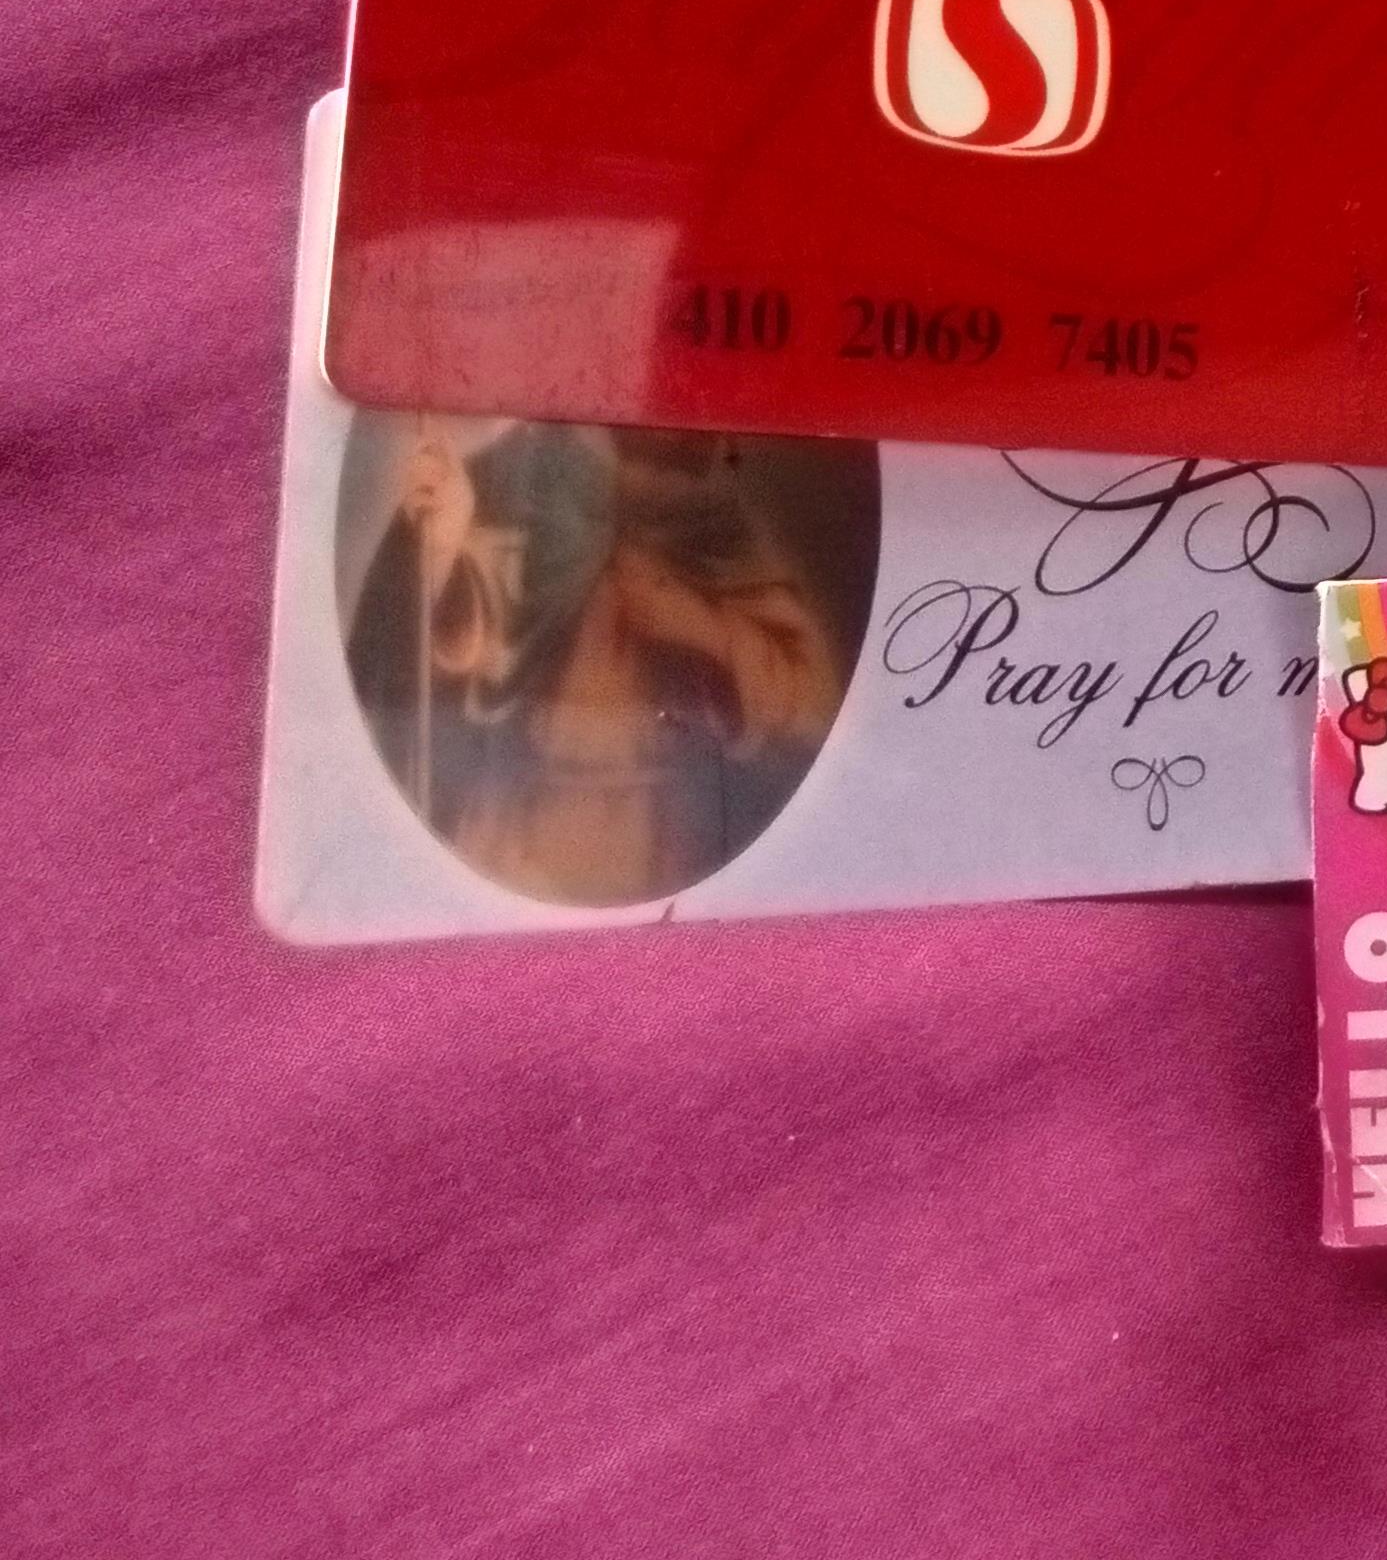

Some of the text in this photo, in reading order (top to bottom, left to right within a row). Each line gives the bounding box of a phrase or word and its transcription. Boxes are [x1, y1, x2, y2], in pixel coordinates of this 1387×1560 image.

[839, 295, 1002, 365] 2069
[1049, 313, 1200, 381] 7405
[883, 579, 1124, 748] Pray
[1122, 610, 1250, 728] for
